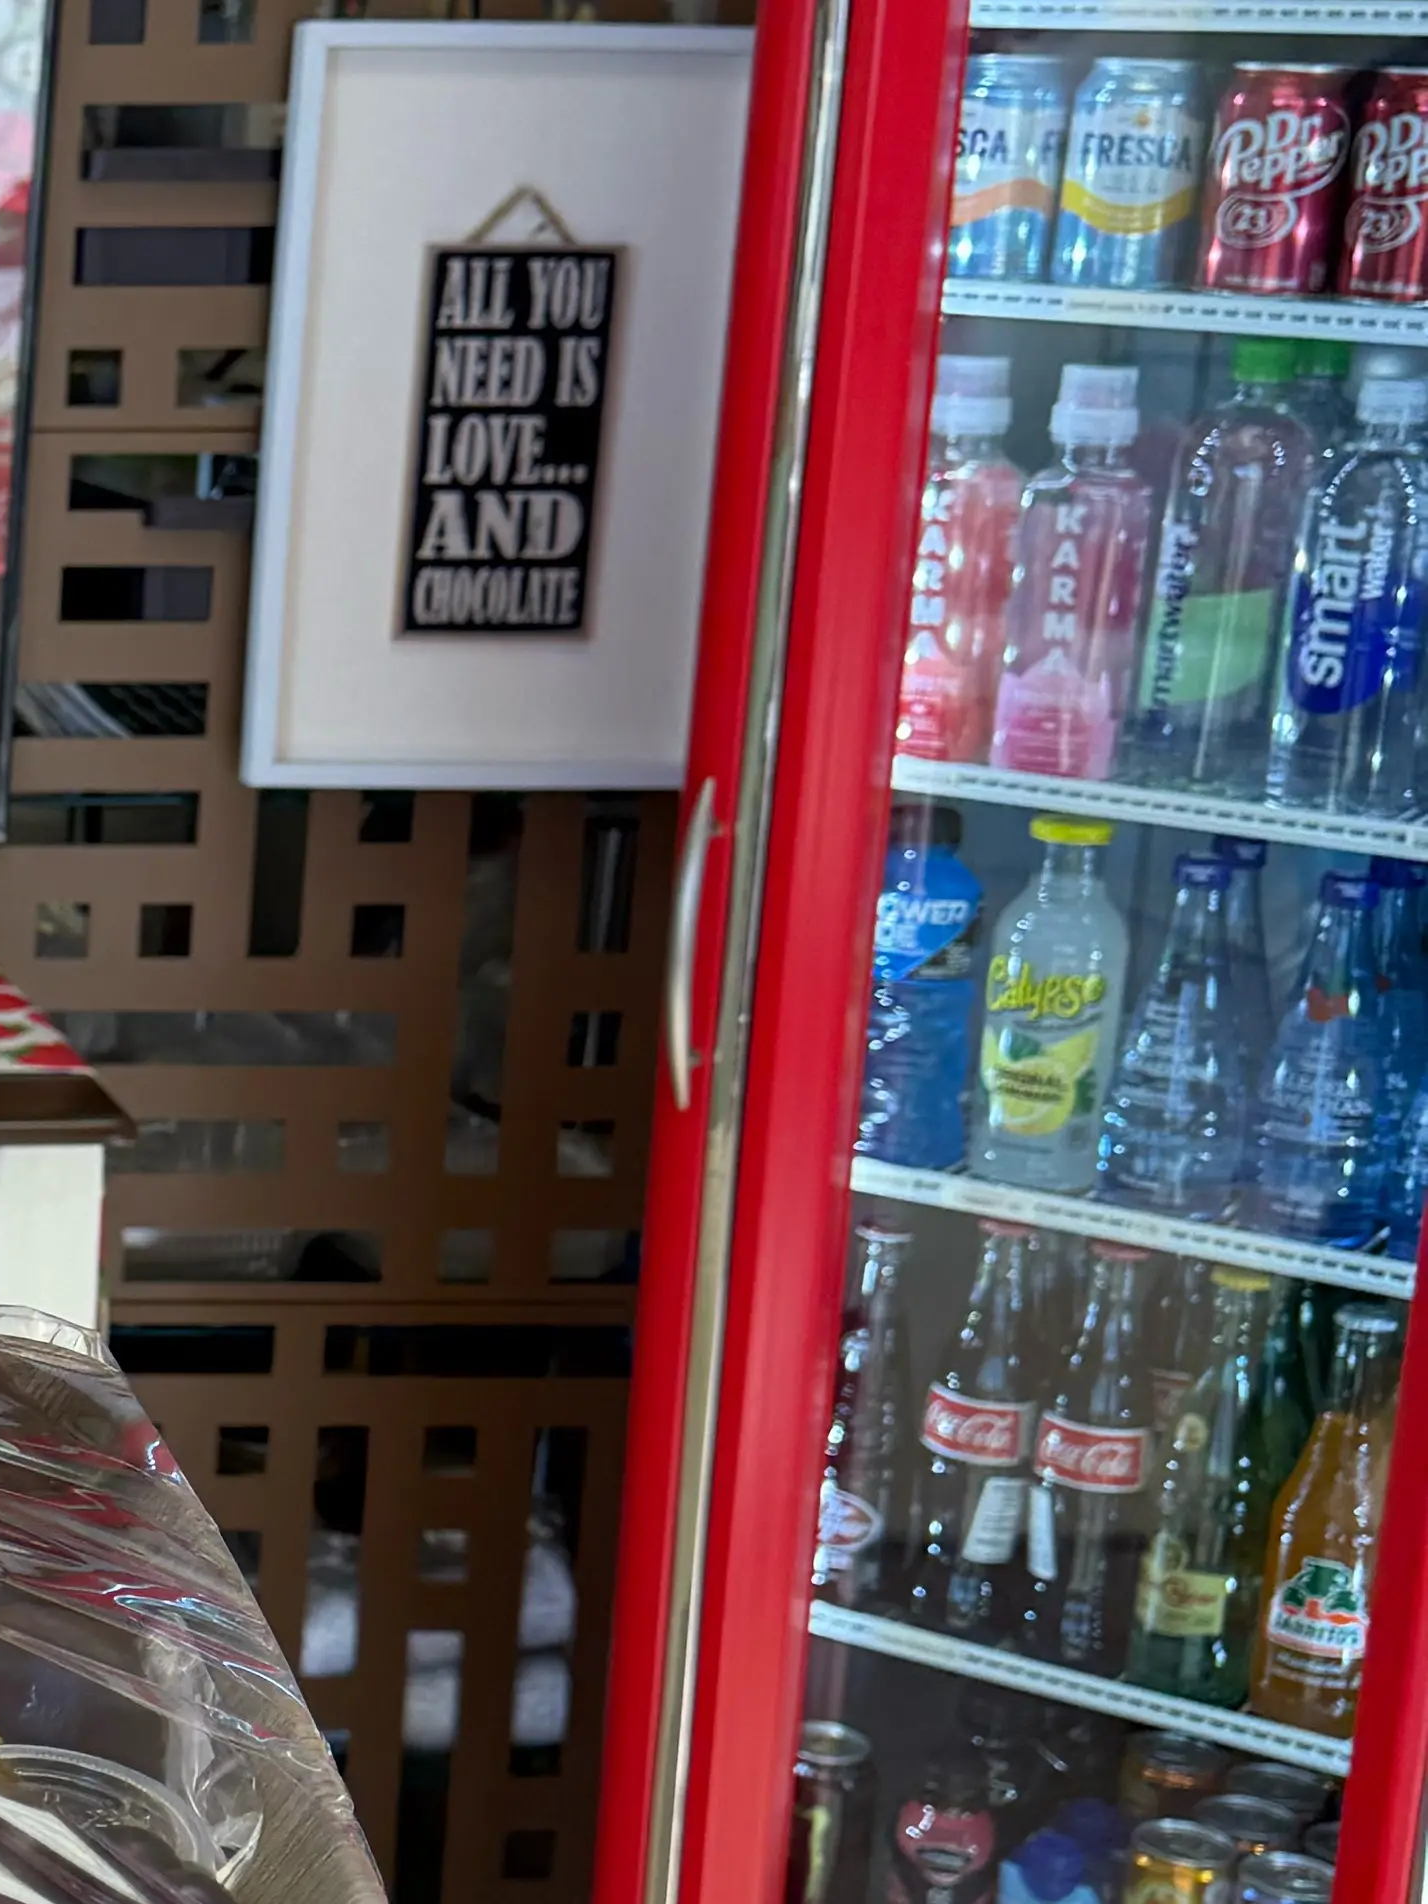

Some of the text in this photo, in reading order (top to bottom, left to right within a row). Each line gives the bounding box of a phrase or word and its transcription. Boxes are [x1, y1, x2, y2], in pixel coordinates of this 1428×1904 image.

[1080, 132, 1192, 170] FRESCA
[1214, 118, 1344, 191] Pepper
[1266, 110, 1324, 153] Dr
[1352, 121, 1428, 192] Pepp
[436, 256, 611, 330] ALL YOU
[429, 336, 601, 408] NEED IS
[415, 490, 585, 561] AND
[412, 565, 580, 626] CHOCOLATE
[1037, 504, 1087, 676] KARMA
[1297, 516, 1367, 689] smart
[877, 893, 970, 925] OWER
